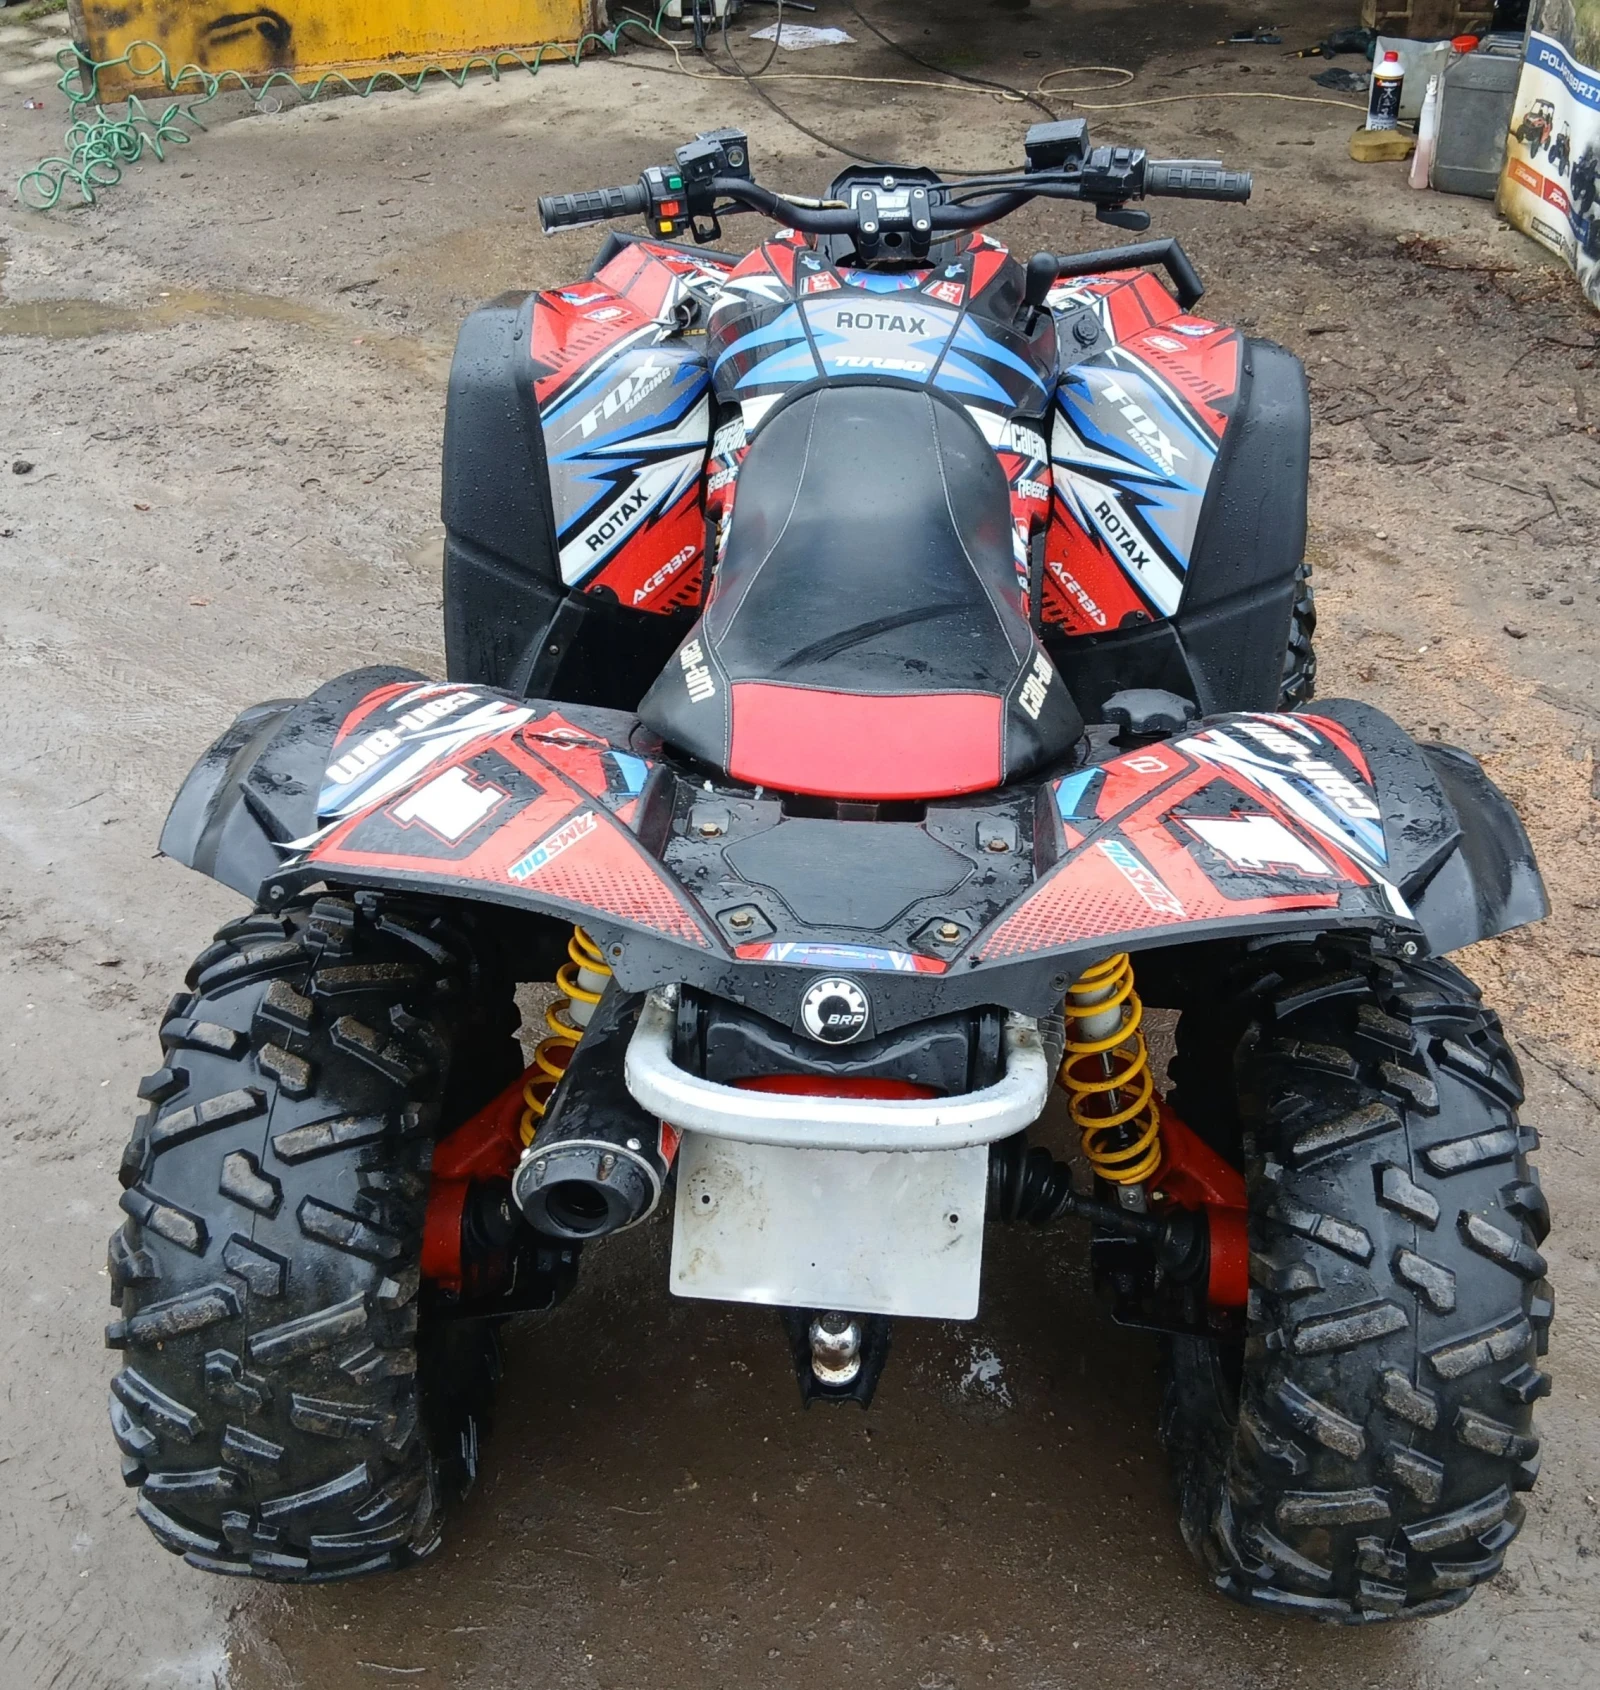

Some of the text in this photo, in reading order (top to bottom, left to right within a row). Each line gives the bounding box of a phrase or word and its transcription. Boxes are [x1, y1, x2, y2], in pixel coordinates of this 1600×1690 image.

[836, 312, 926, 335] ROTAX
[625, 367, 671, 413] RACING
[834, 356, 927, 373] TURBO
[552, 355, 663, 445] FOX
[1101, 371, 1188, 468] FOX
[1126, 428, 1175, 477] RACING
[585, 488, 648, 551] ROTAX
[1094, 501, 1150, 571] ROTAX
[632, 546, 696, 605] ACERBIS
[1050, 561, 1107, 627] ACERBIS
[680, 638, 716, 703] can-am
[1018, 651, 1053, 720] can-am
[325, 691, 483, 785] can-am
[1231, 722, 1381, 821] can-am
[509, 812, 596, 880] AMSOIL
[1102, 841, 1184, 915] AMSOIL
[827, 1014, 864, 1025] BRP
